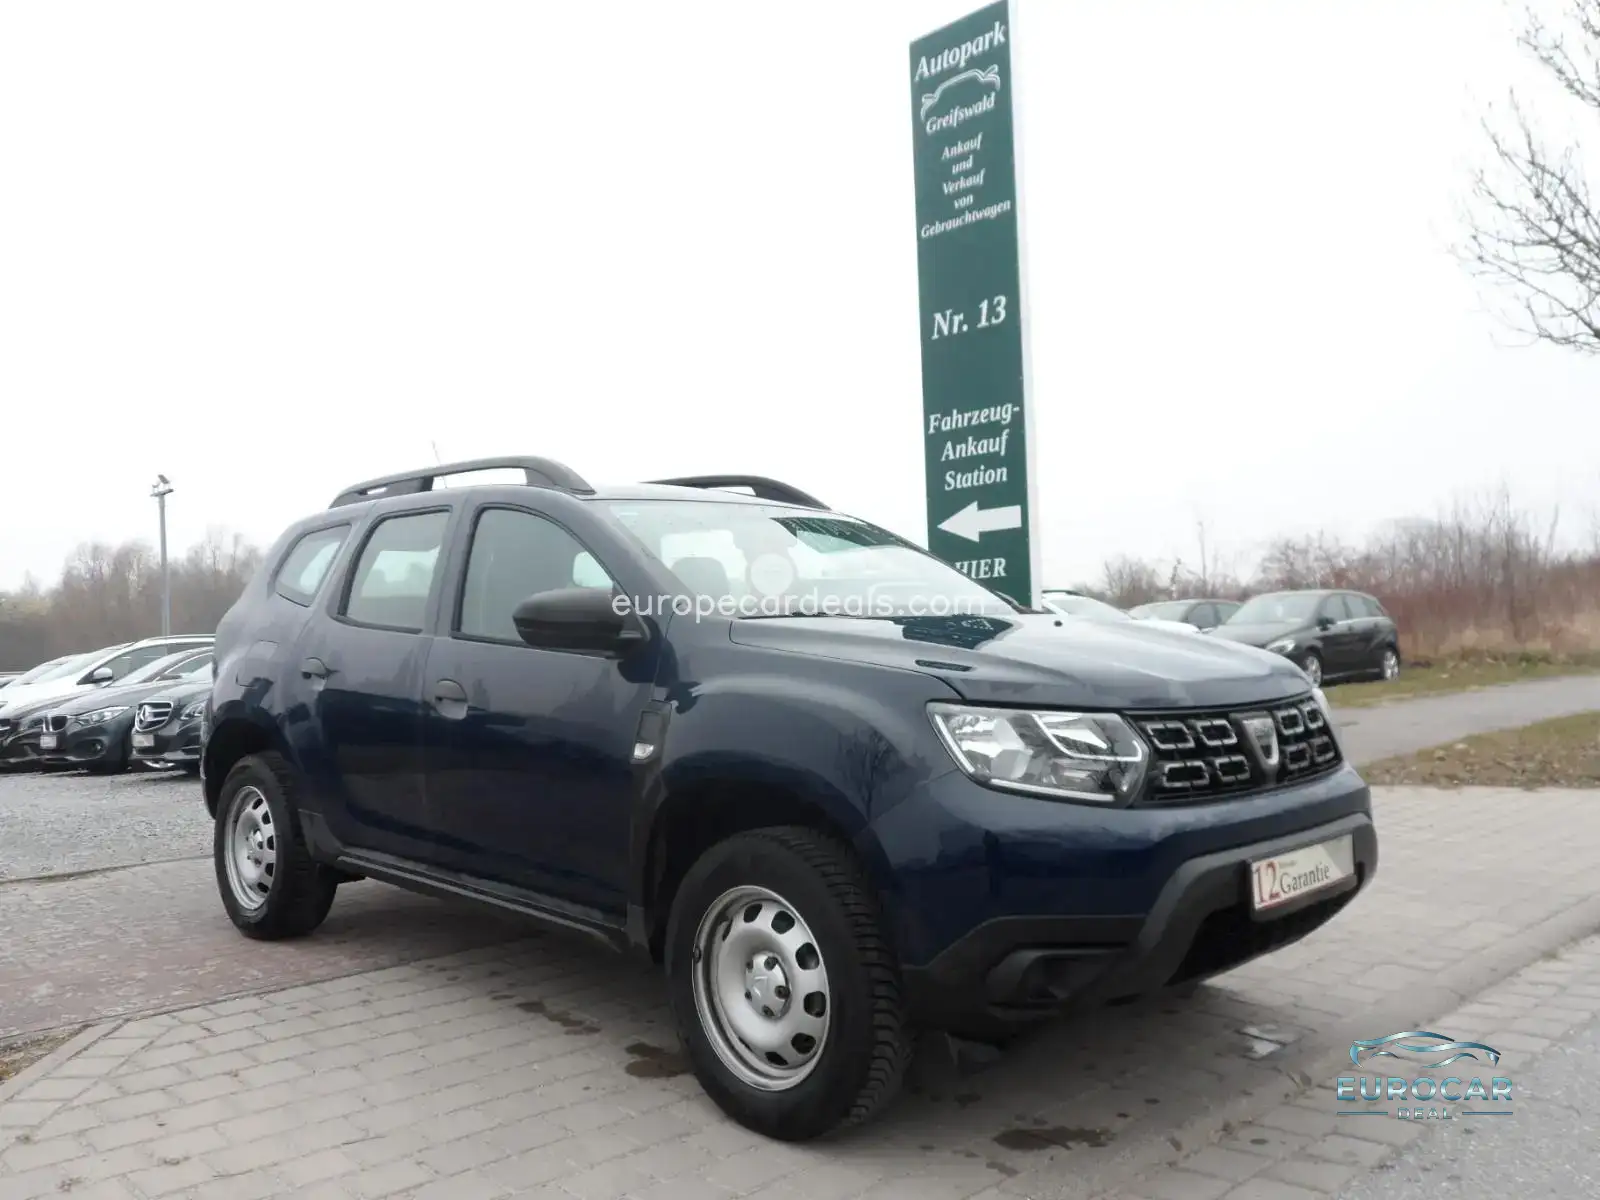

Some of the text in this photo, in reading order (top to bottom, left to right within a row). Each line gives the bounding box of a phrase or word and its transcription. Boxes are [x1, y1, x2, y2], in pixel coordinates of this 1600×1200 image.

[914, 21, 1006, 82] Autopark
[926, 91, 996, 135] Greifswald
[941, 132, 983, 161] Ankauf
[942, 168, 986, 195] Verkauf
[952, 155, 973, 175] und
[954, 194, 974, 209] von
[921, 200, 1011, 239] Gebrauchtwagen
[931, 294, 1007, 340] Nr. 13
[928, 402, 1020, 435] Fahrzeug-
[941, 428, 1010, 462] Ankauf
[944, 464, 1008, 491] Station
[1253, 861, 1330, 903] 12 Garantie
